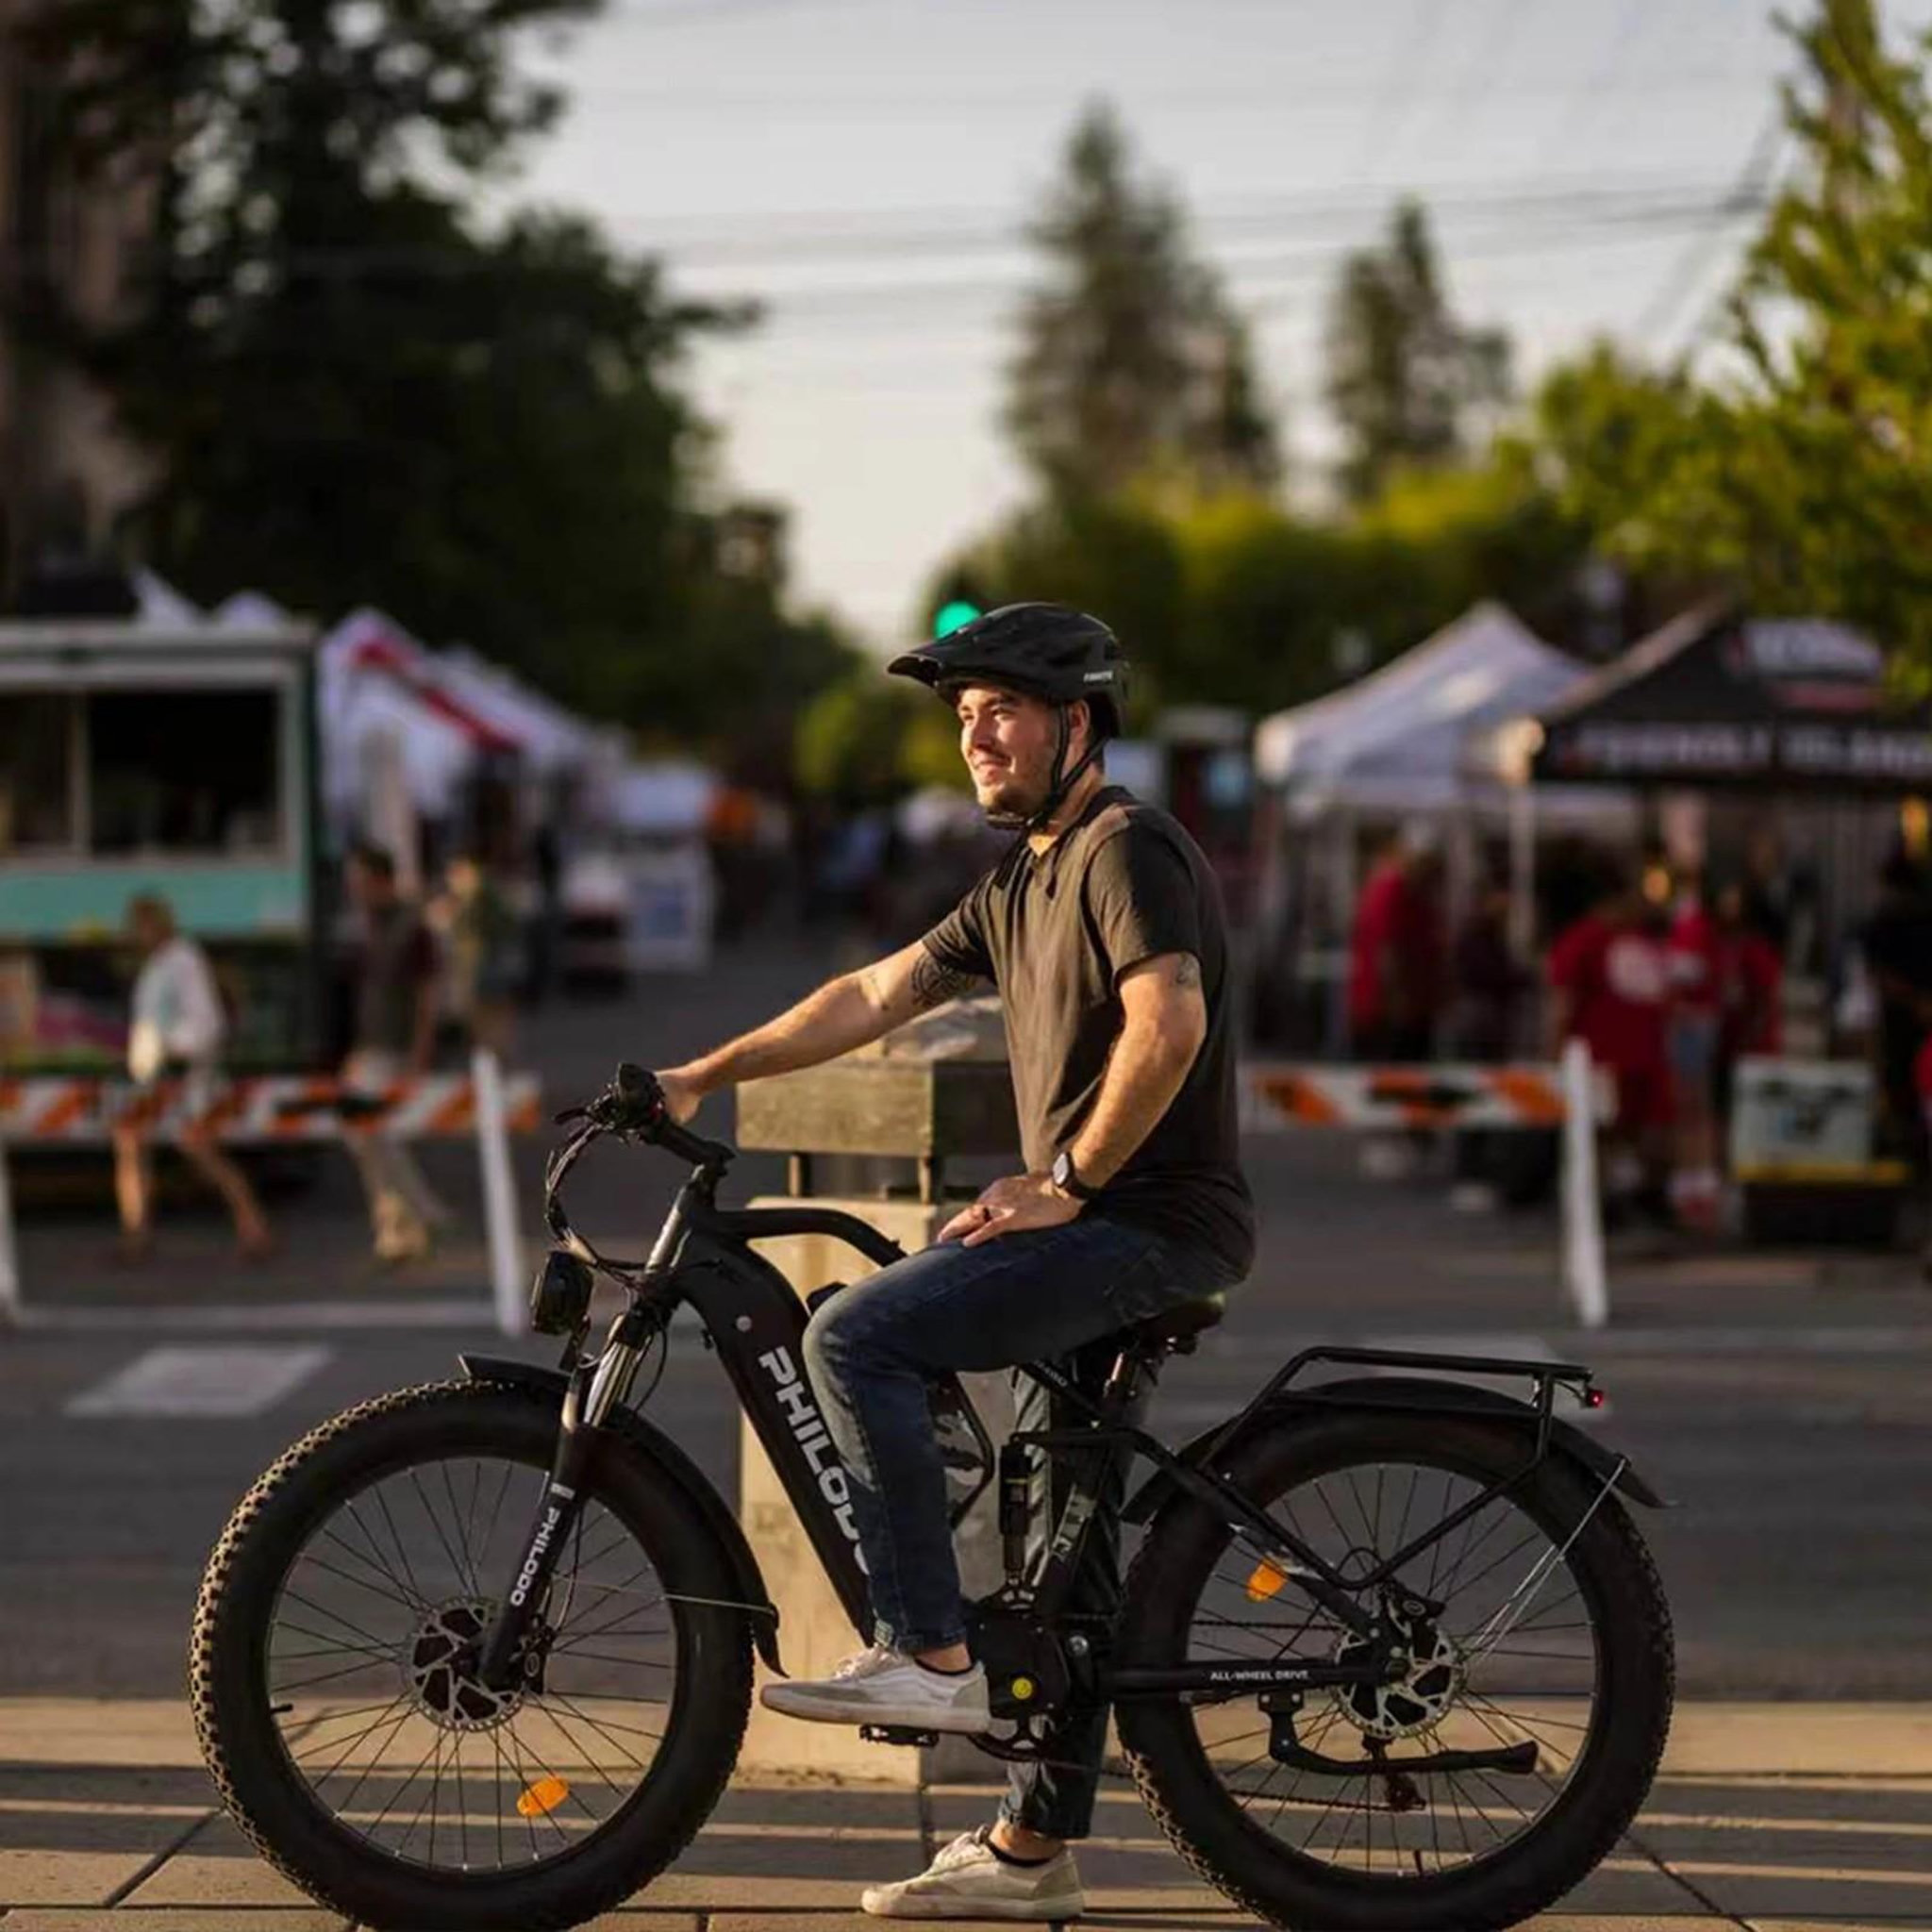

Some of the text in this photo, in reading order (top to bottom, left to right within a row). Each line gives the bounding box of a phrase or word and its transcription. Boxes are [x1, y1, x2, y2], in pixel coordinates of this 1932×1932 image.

[758, 1345, 870, 1574] PHILOD
[509, 1507, 560, 1607] PHILODO
[1210, 1670, 1308, 1681] ALL-WHEEL DRIVE
